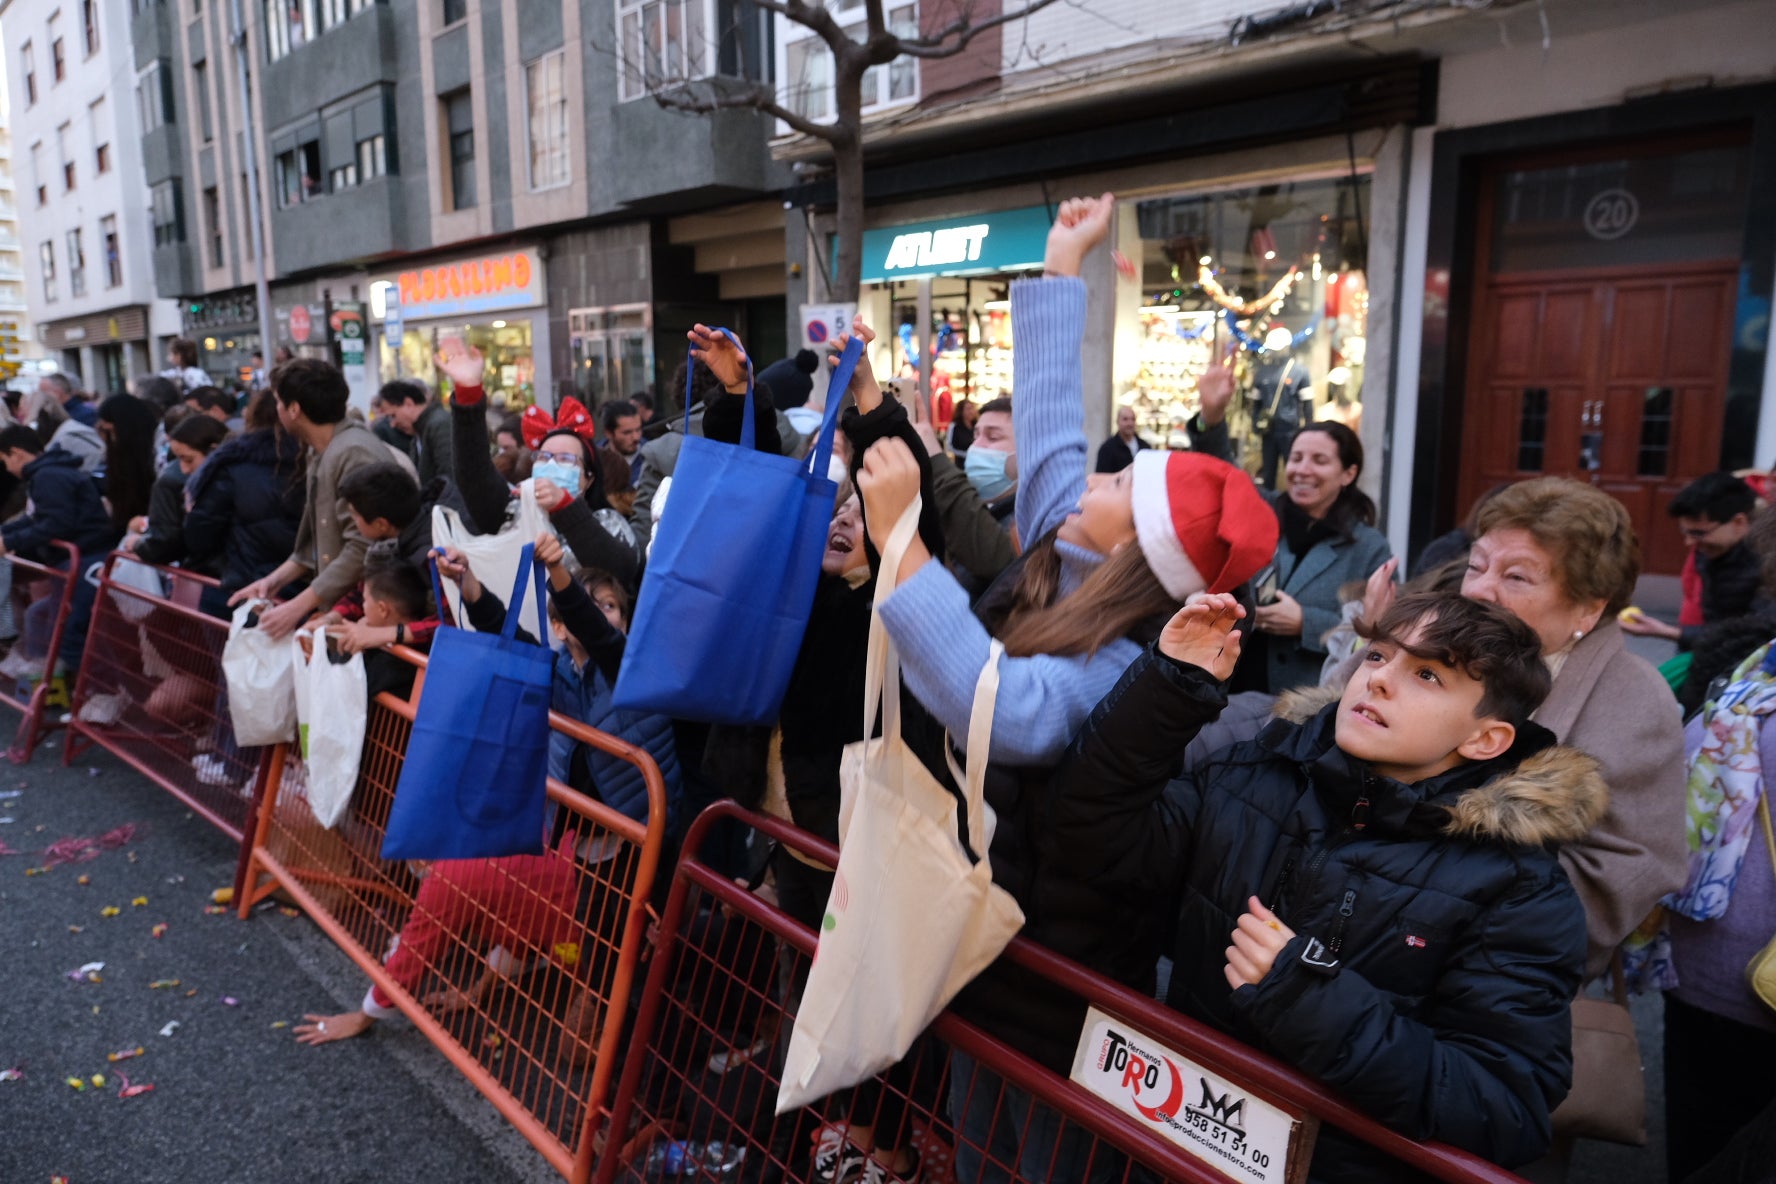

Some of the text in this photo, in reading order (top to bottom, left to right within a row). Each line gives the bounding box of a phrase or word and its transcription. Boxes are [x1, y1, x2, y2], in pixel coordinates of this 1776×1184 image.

[1596, 200, 1628, 229] 20
[1097, 1038, 1110, 1070] GRUPO
[1103, 1029, 1159, 1096] TORO
[1127, 1040, 1162, 1067] Hermanos
[1155, 1110, 1266, 1181] info@produccionestoro.com
[1185, 1109, 1270, 1169] 958 51 51 00
